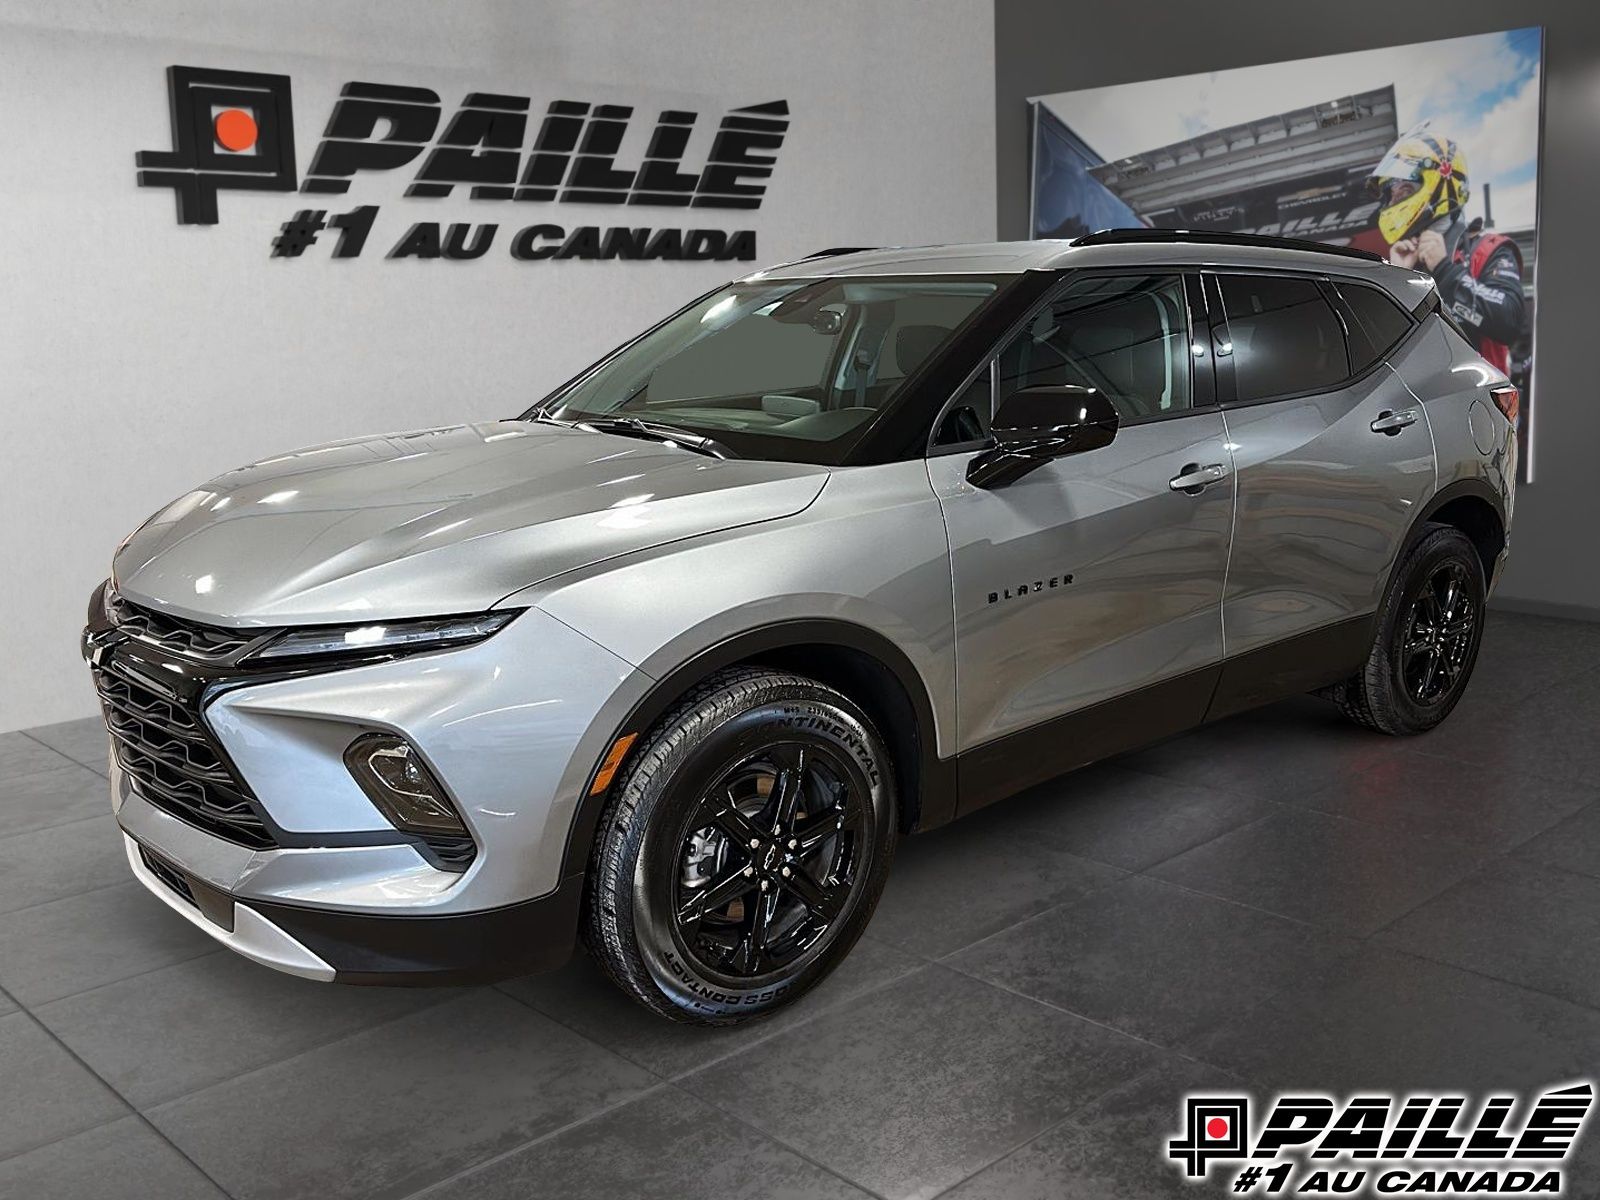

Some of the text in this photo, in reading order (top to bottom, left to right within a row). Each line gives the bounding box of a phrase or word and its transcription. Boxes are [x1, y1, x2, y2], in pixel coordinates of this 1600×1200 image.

[302, 81, 790, 210] PAILLÉ
[270, 206, 757, 261] #1 AU CANADA
[987, 574, 1074, 604] BLAZER
[752, 716, 880, 787] NTINENTAL
